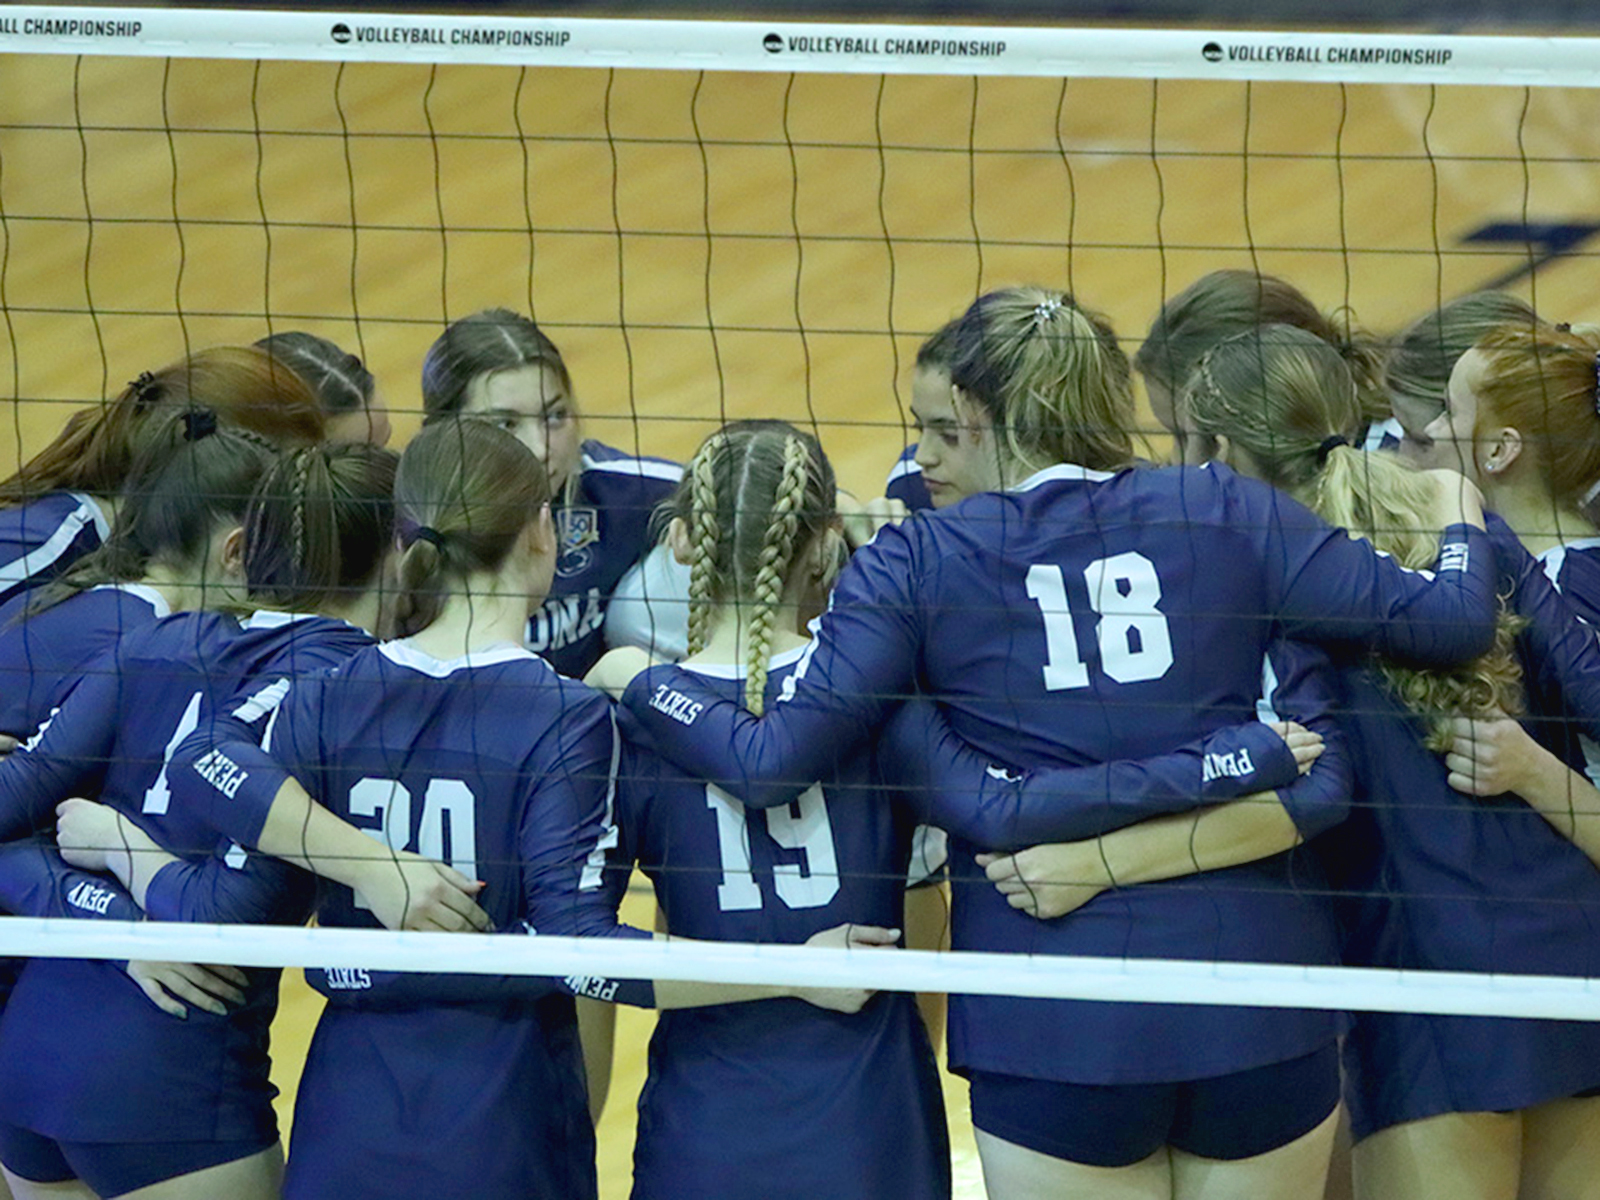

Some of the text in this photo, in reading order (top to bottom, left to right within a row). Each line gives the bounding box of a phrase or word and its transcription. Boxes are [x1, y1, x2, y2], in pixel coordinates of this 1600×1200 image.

[24, 19, 142, 36] CHAMPIONSHIP
[356, 27, 570, 46] VOLLEYBALL CHAMPIONSHIP
[788, 37, 1006, 57] VOLLEYBALL CHAMPIONSHIP
[1228, 45, 1452, 65] VOLLEYBALL CHAMPIONSHIP
[1025, 550, 1174, 690] 18
[648, 684, 704, 725] STATE
[1202, 748, 1255, 782] PENN
[349, 777, 478, 908] 20
[705, 780, 840, 910] 19
